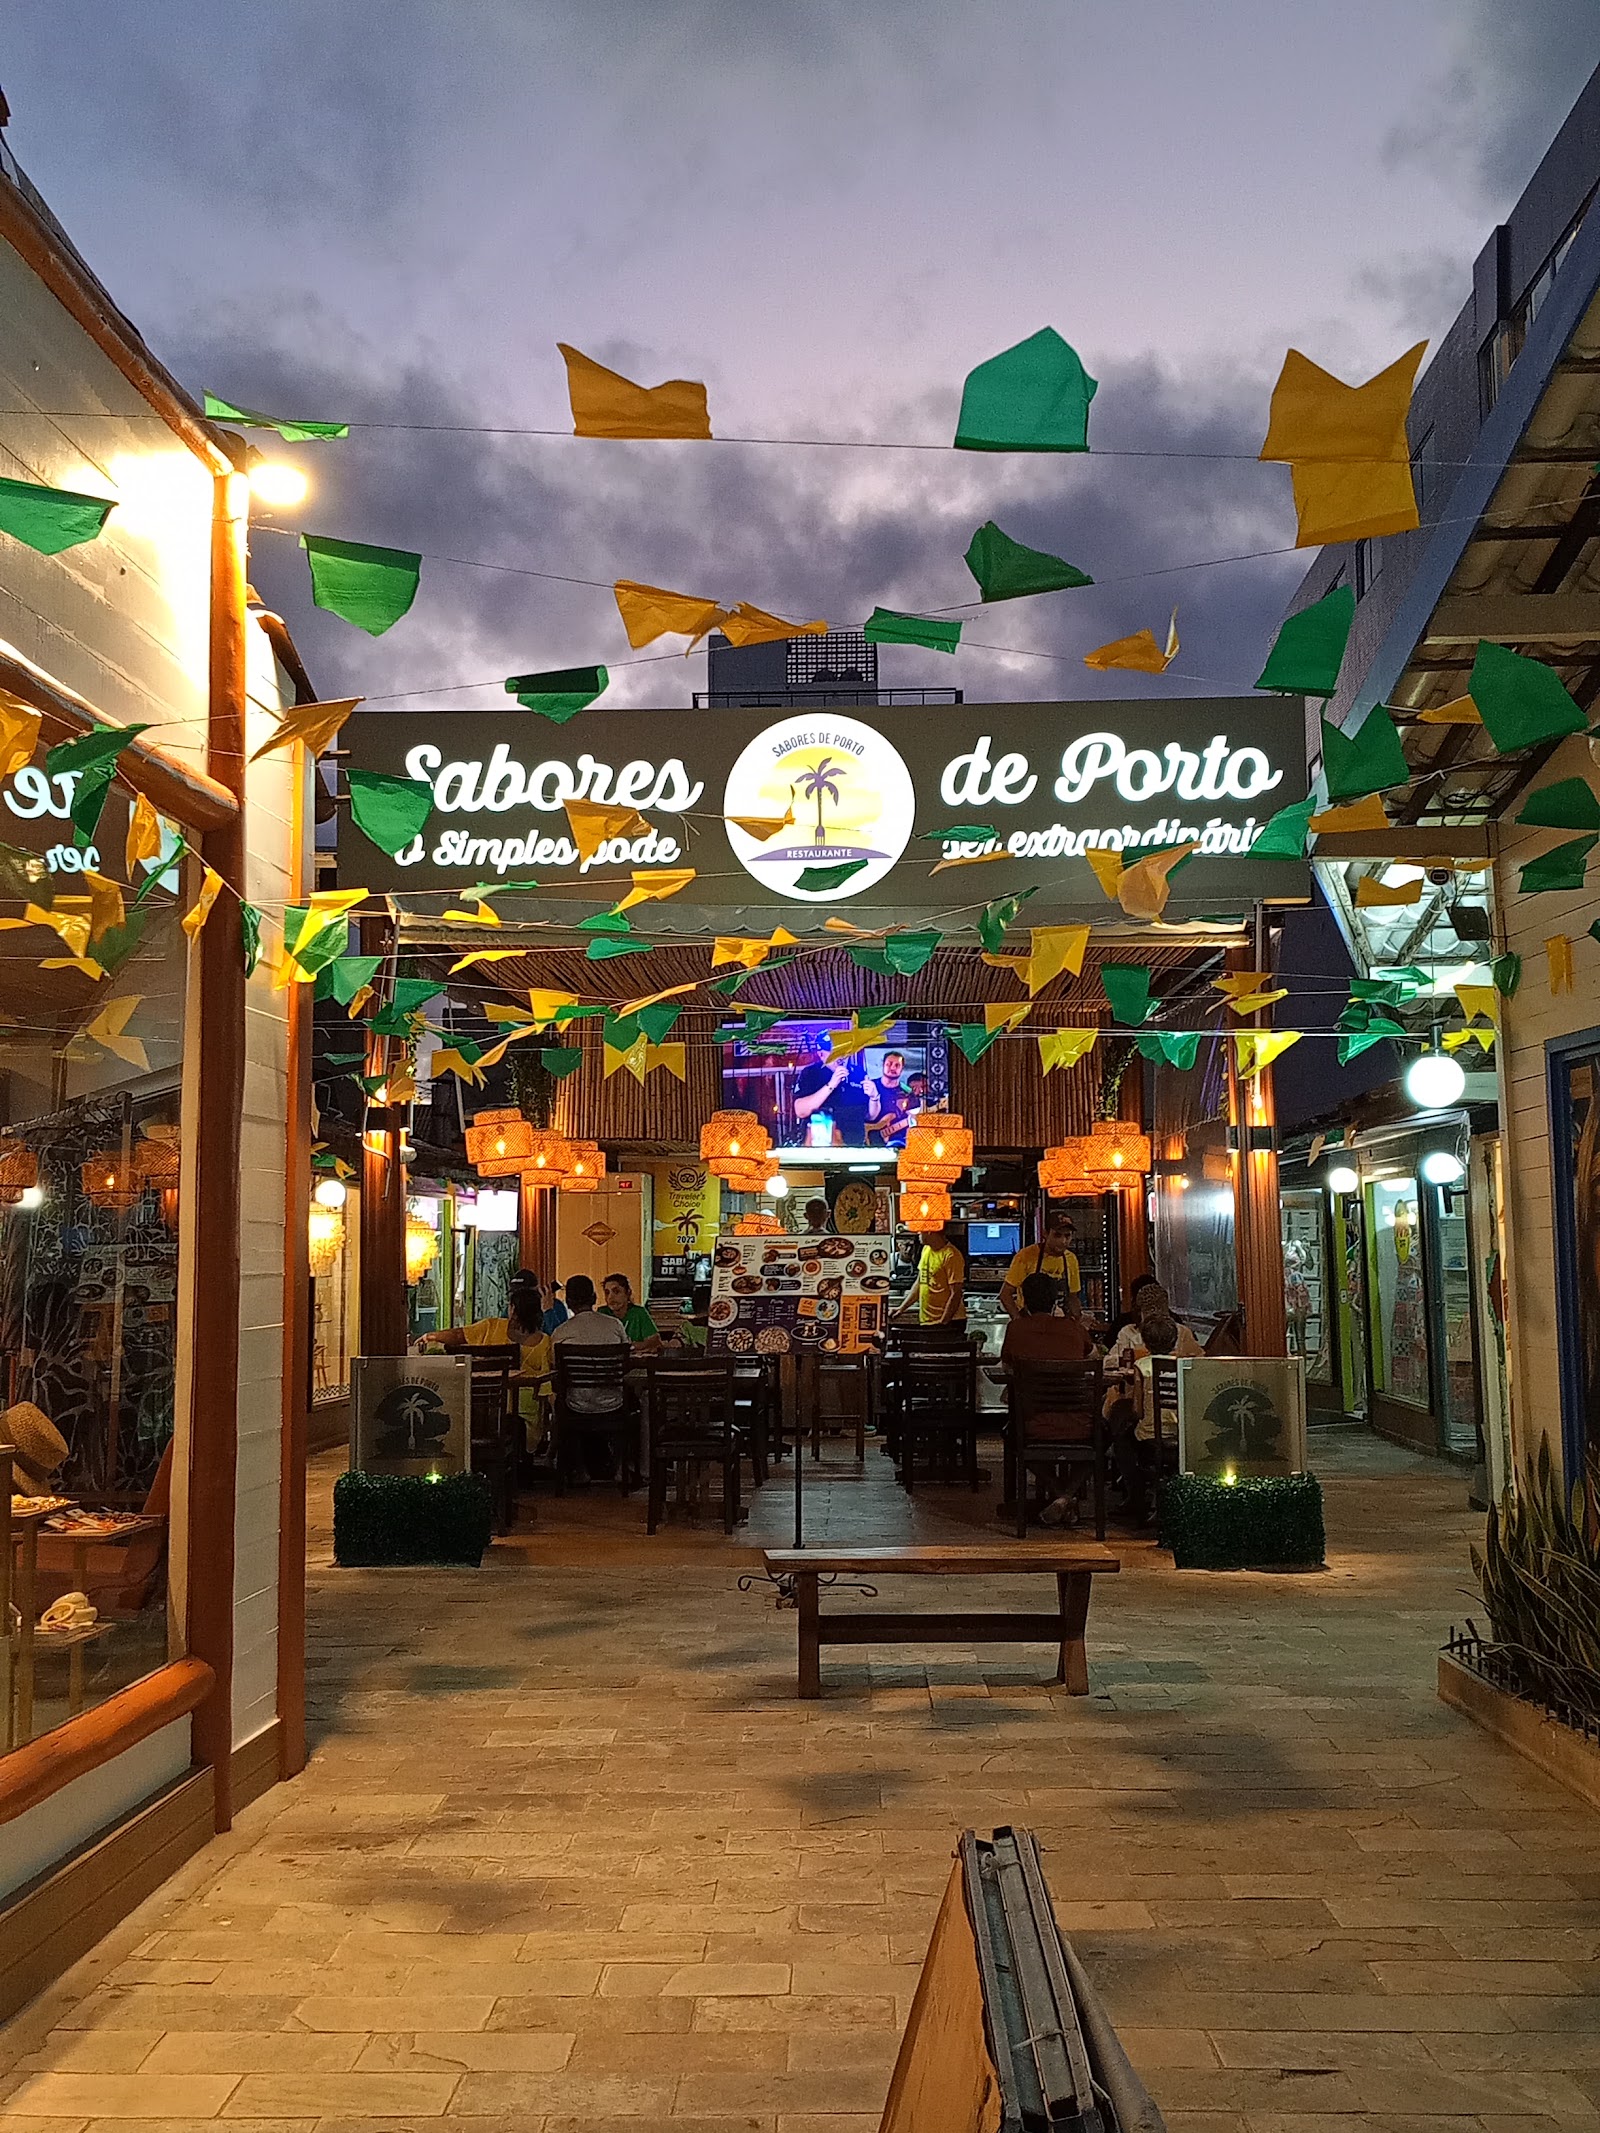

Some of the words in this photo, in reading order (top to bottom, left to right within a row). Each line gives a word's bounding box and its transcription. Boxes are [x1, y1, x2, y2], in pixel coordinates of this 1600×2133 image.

[772, 732, 816, 757] SABORES
[818, 732, 831, 744] DE
[833, 734, 865, 756] PORTO
[405, 743, 705, 813] Sabores
[940, 735, 1039, 807] de
[1054, 732, 1284, 802] Porto
[432, 829, 580, 875] Simples
[786, 848, 852, 859] RESTAURANTE
[673, 1199, 701, 1208] Choice
[661, 1267, 674, 1275] DE
